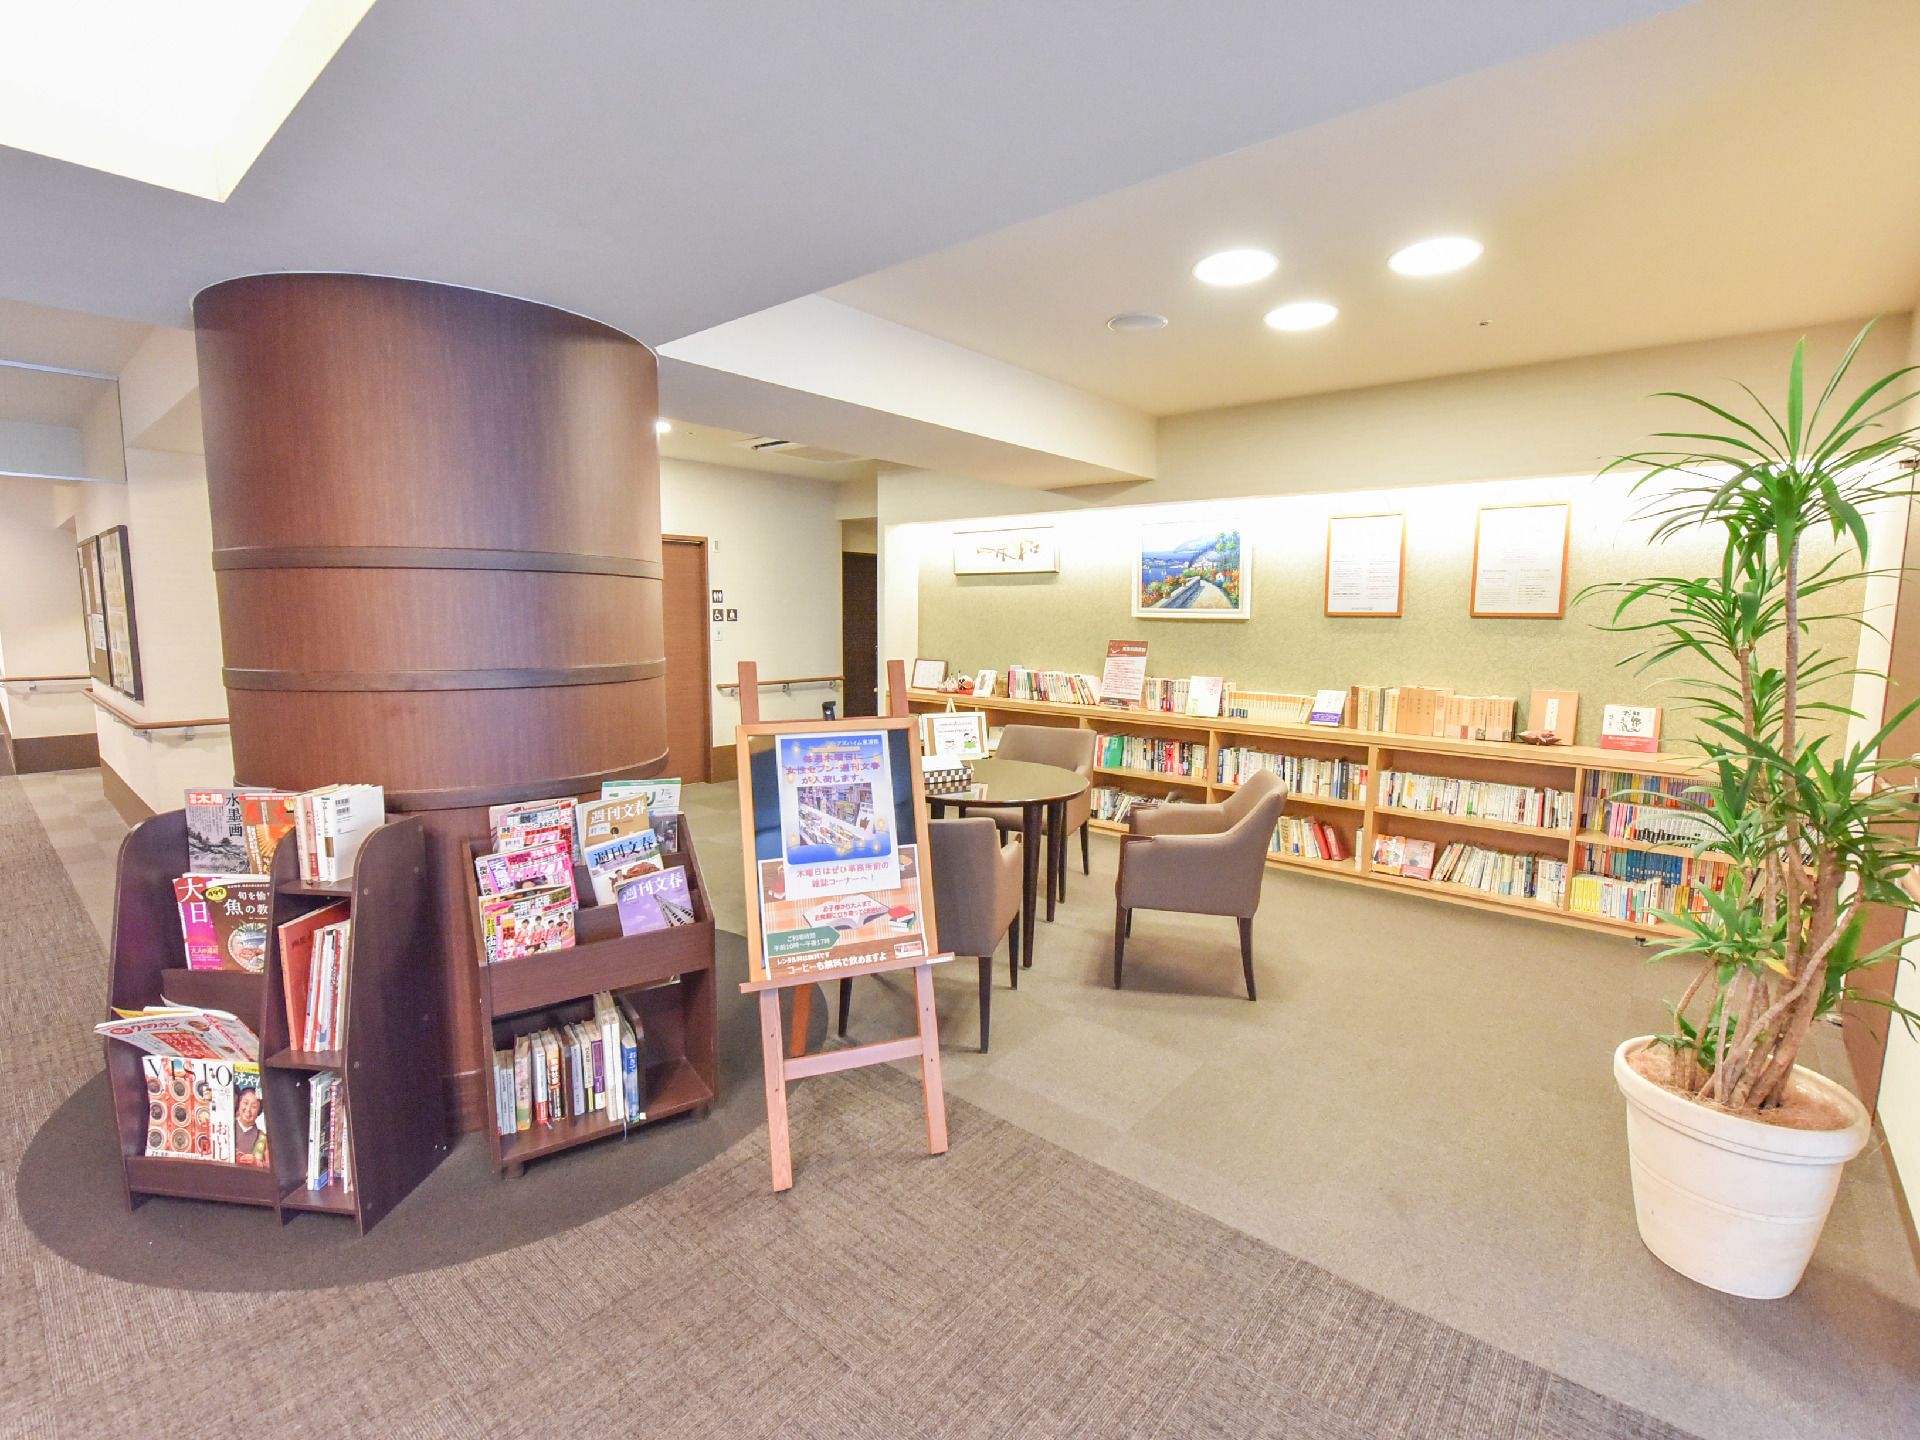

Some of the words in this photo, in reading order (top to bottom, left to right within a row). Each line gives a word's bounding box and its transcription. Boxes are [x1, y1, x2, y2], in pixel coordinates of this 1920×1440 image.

[226, 792, 243, 837] 水墨画
[591, 800, 646, 824] 週刊文春
[594, 837, 654, 866] 週刊文春
[622, 872, 683, 902] 週刊文春
